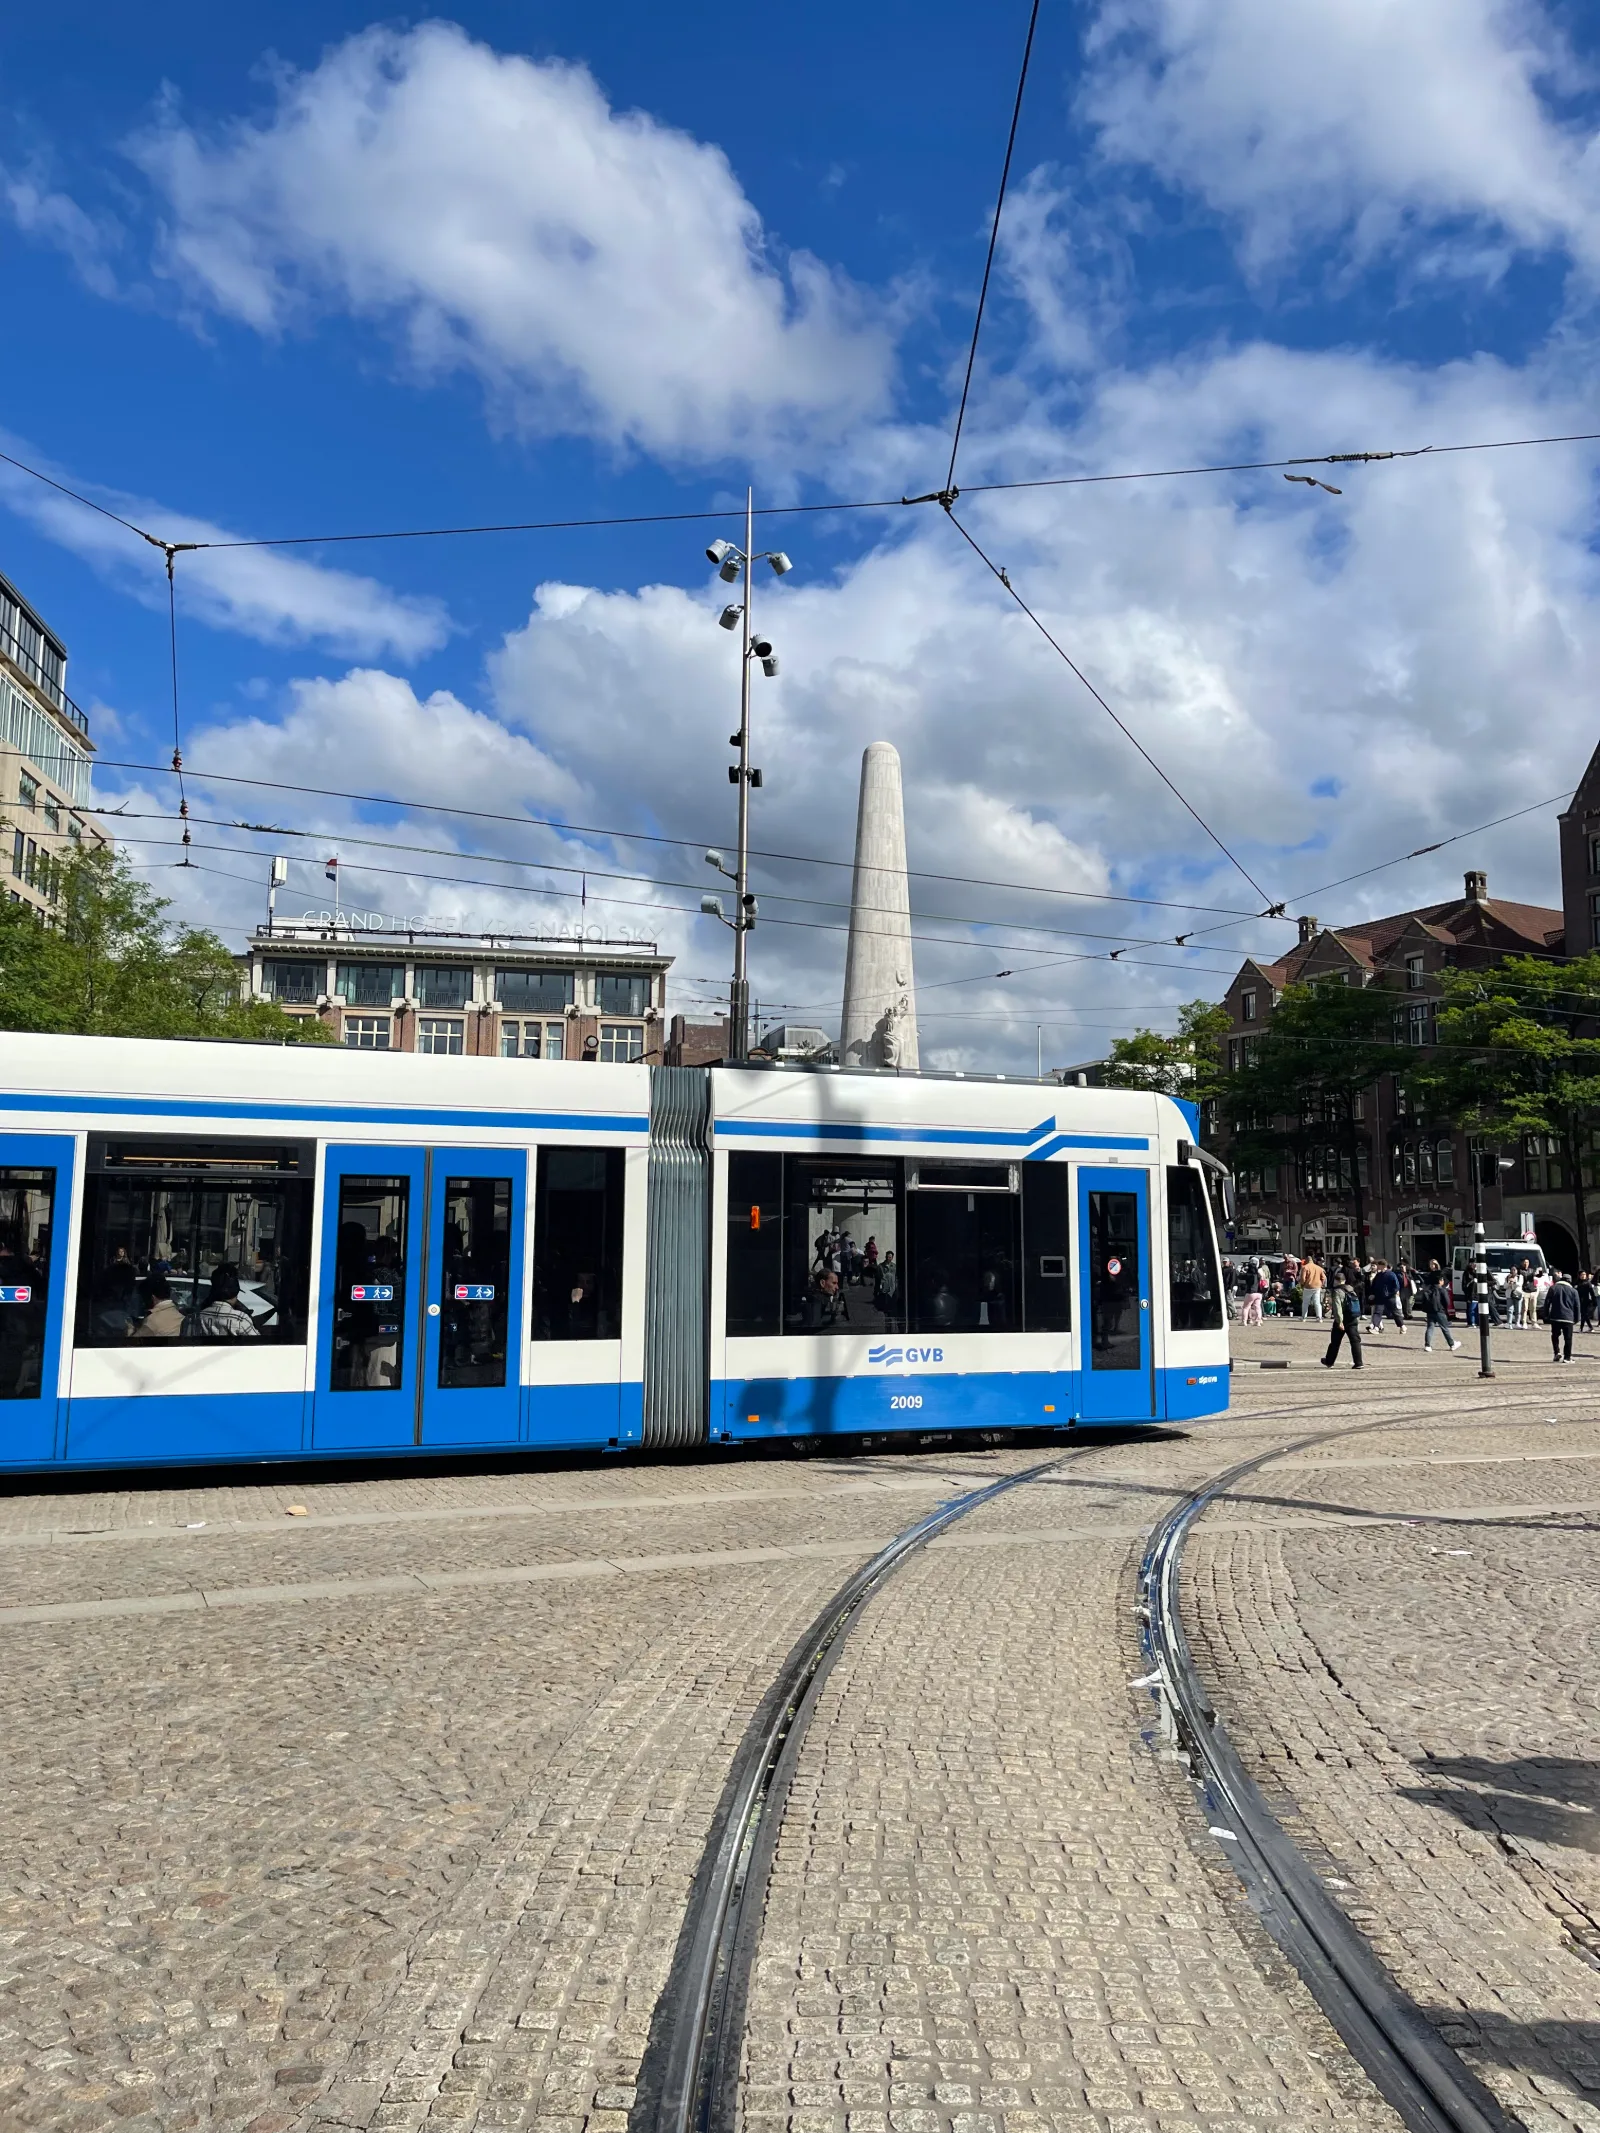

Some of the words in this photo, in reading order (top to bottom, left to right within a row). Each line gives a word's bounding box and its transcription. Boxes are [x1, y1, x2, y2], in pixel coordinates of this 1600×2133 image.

[303, 910, 383, 931] GRAND
[392, 914, 469, 935] HOTEL
[481, 918, 666, 942] KRASNAPOLSKY
[905, 1348, 944, 1363] GVB
[890, 1395, 923, 1409] 2009
